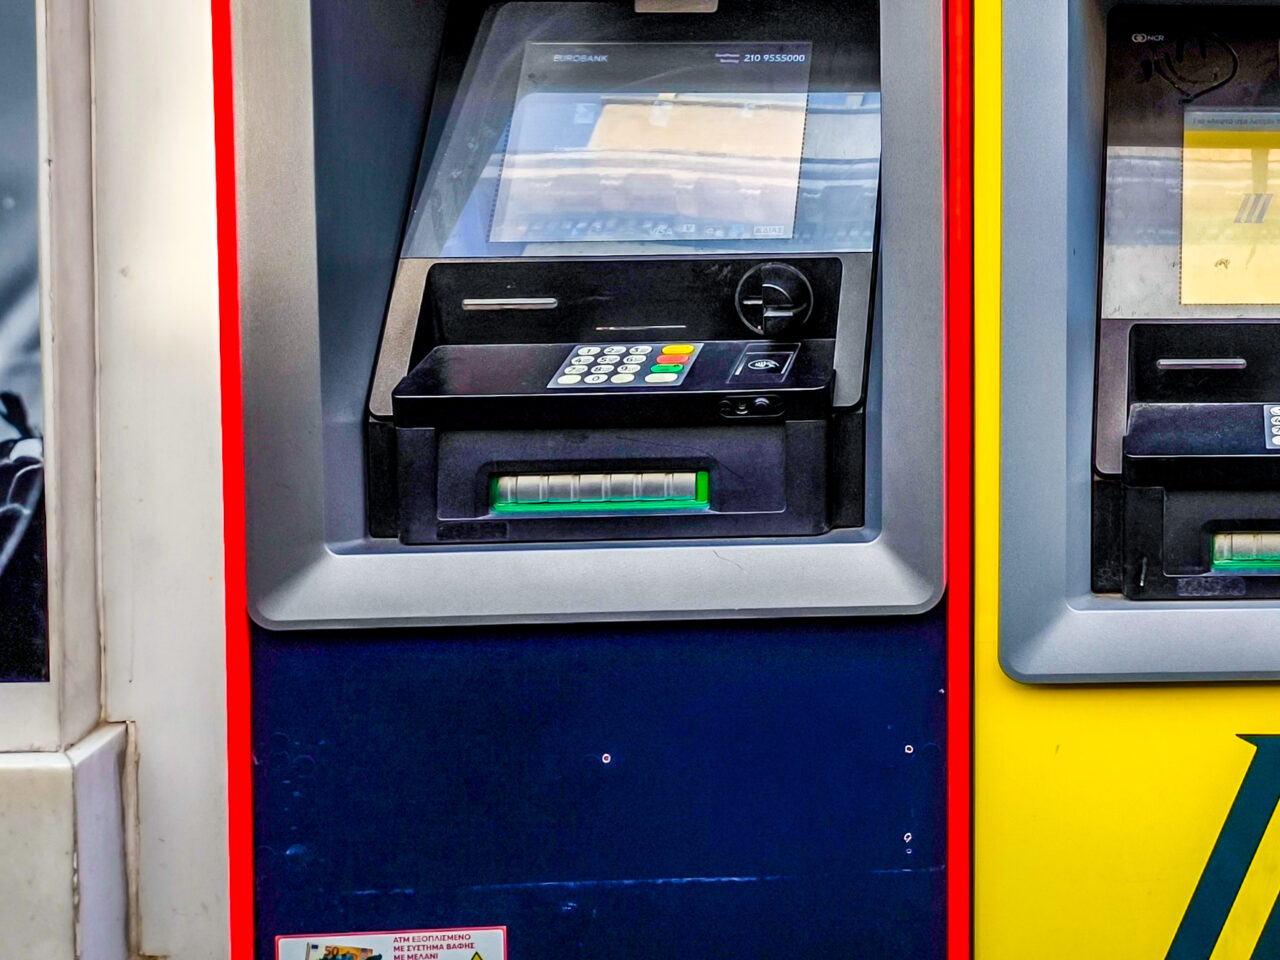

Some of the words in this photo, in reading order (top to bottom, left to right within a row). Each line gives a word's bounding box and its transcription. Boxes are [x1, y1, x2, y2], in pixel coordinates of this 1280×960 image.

[553, 54, 608, 63] EUROBANK
[743, 53, 761, 62] 210
[763, 53, 806, 62] 9555000
[393, 945, 406, 953] ΜΕ
[407, 943, 445, 952] ΣΥΣΤΗΜΑ
[446, 942, 476, 950] ΒΑΦΗΣ
[407, 952, 439, 960] ΜΕΛΑΝΙ
